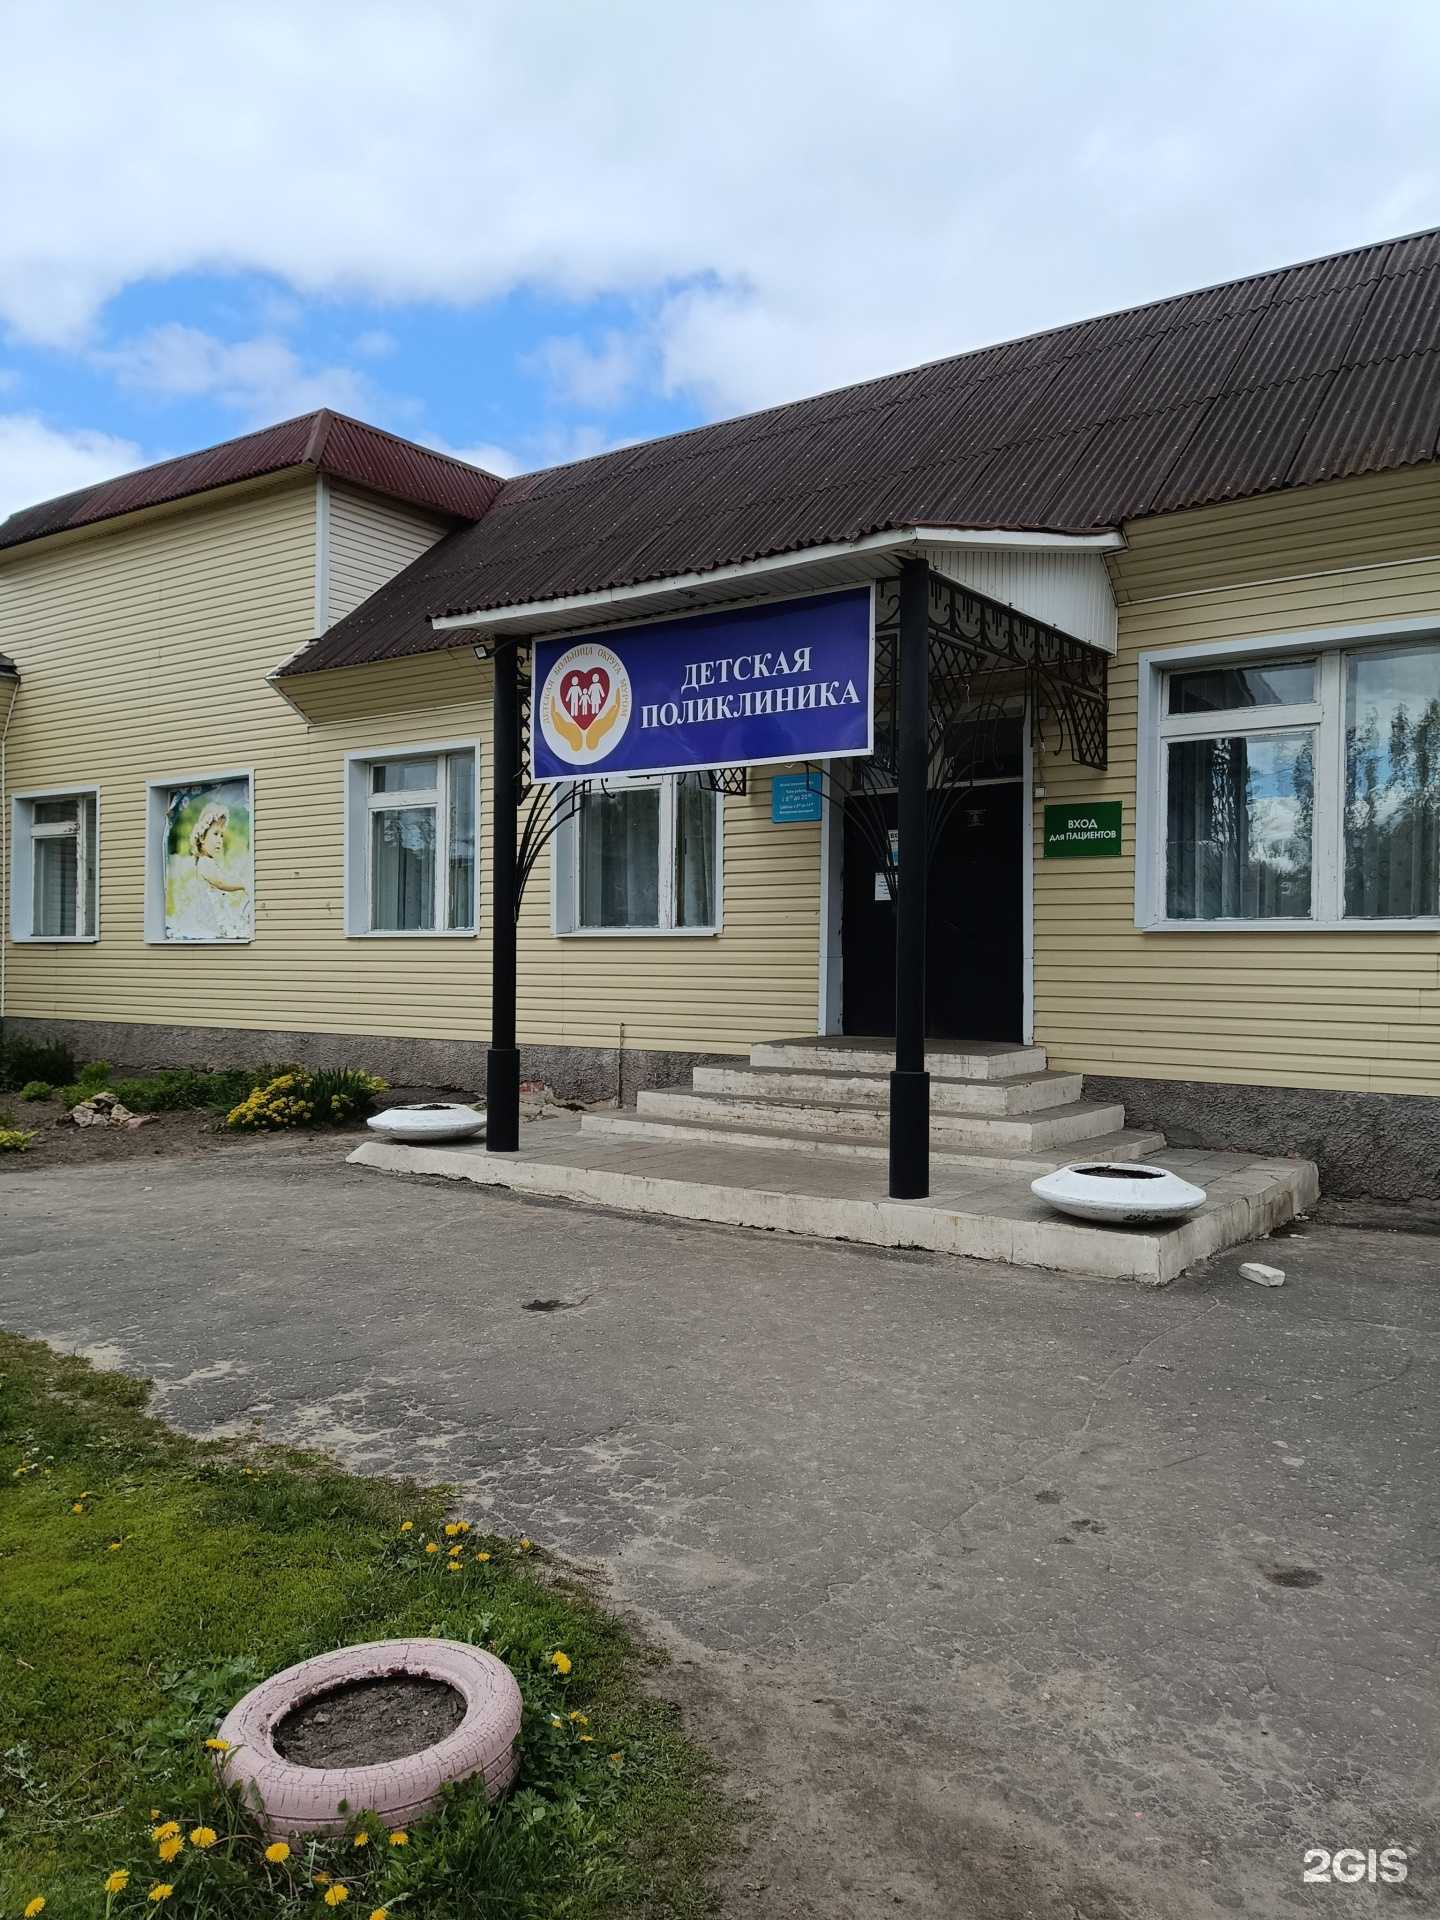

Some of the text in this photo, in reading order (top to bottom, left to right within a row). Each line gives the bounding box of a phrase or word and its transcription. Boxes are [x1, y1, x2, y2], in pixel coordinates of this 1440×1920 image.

[554, 647, 593, 676] БОЛЬНИЦА
[597, 648, 622, 674] ОКРУГА
[680, 647, 813, 694] ДЕТСКАЯ
[640, 679, 861, 728] ПОЛИКЛИНИКА
[1066, 830, 1117, 840] ПАЦИЕНТОВ
[1068, 818, 1098, 829] ВХОД
